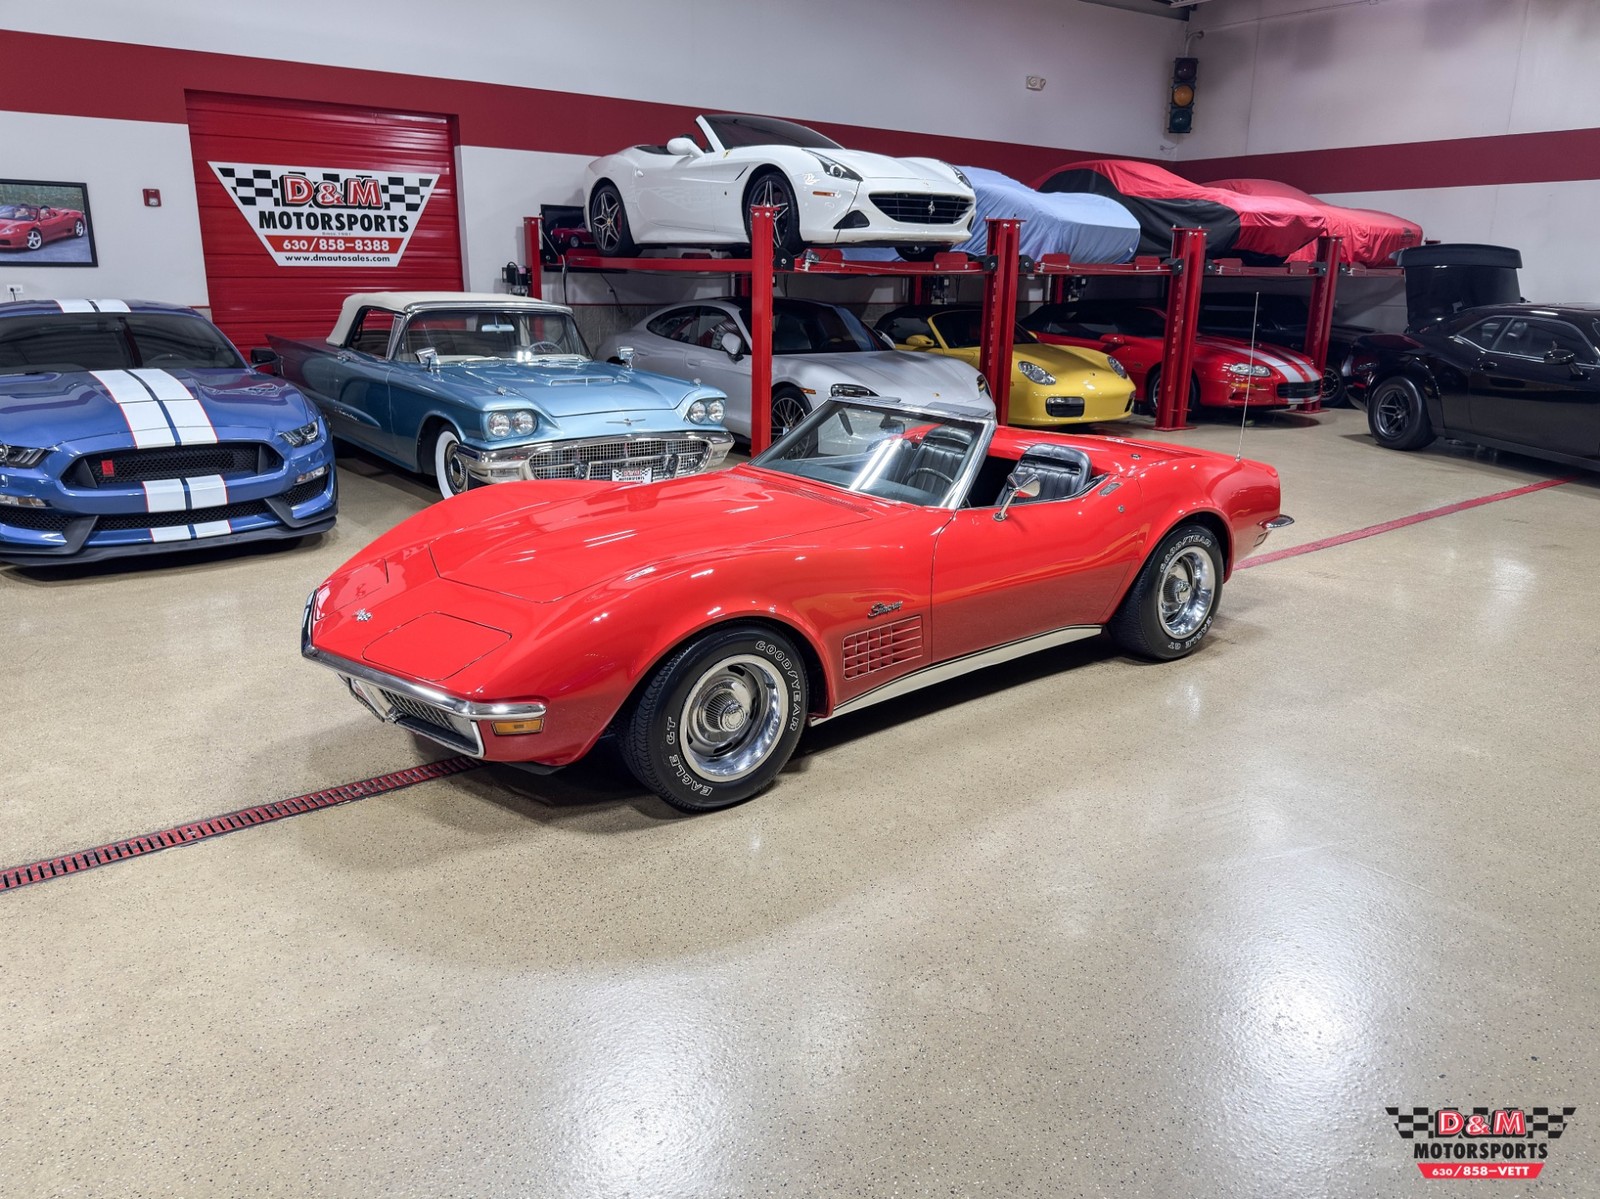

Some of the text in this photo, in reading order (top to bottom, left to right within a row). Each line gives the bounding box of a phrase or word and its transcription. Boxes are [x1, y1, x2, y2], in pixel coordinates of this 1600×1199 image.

[279, 174, 383, 209] D&M
[259, 211, 409, 233] MOTORSPORTS
[283, 237, 390, 252] 630/858-8388
[285, 254, 390, 262] www.dmautosales.com
[1160, 534, 1211, 573] GOODYEAR
[755, 640, 801, 732] GOODYEAR
[666, 716, 713, 797] EAGLE GT
